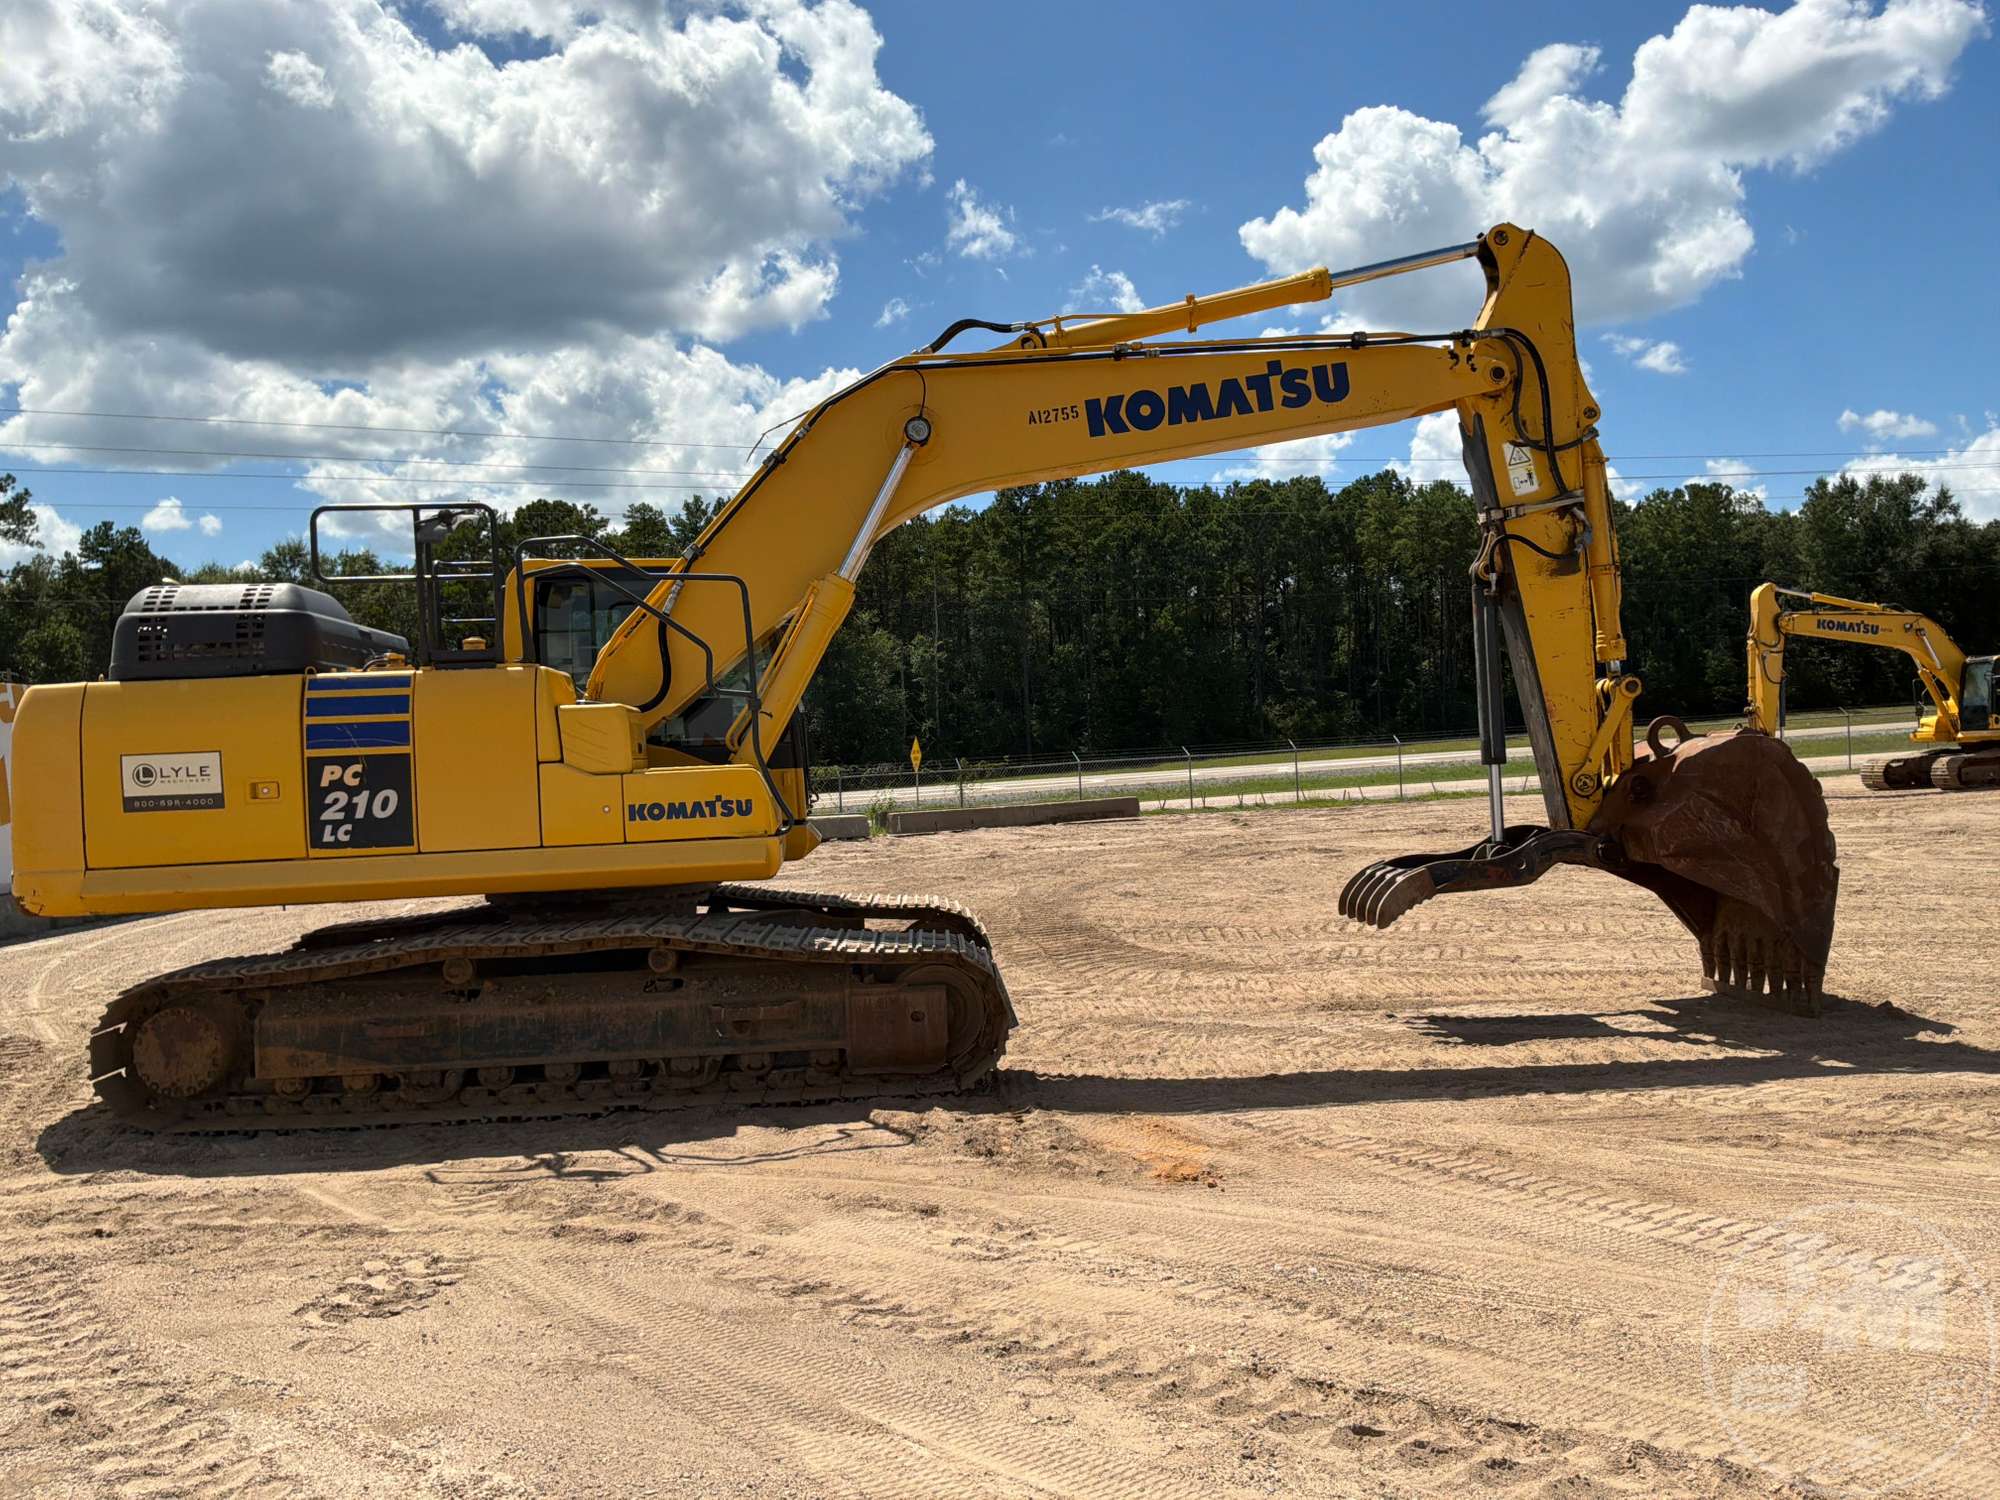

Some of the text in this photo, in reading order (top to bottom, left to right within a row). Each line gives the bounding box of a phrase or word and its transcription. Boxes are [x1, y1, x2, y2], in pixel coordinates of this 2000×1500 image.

[1084, 360, 1350, 437] KOMATSU
[1816, 618, 1880, 635] KOMATSU
[160, 766, 210, 778] LYLE
[320, 764, 363, 787] PC
[320, 789, 398, 820] 210
[627, 795, 753, 821] KOMATSU
[322, 823, 353, 842] LC
